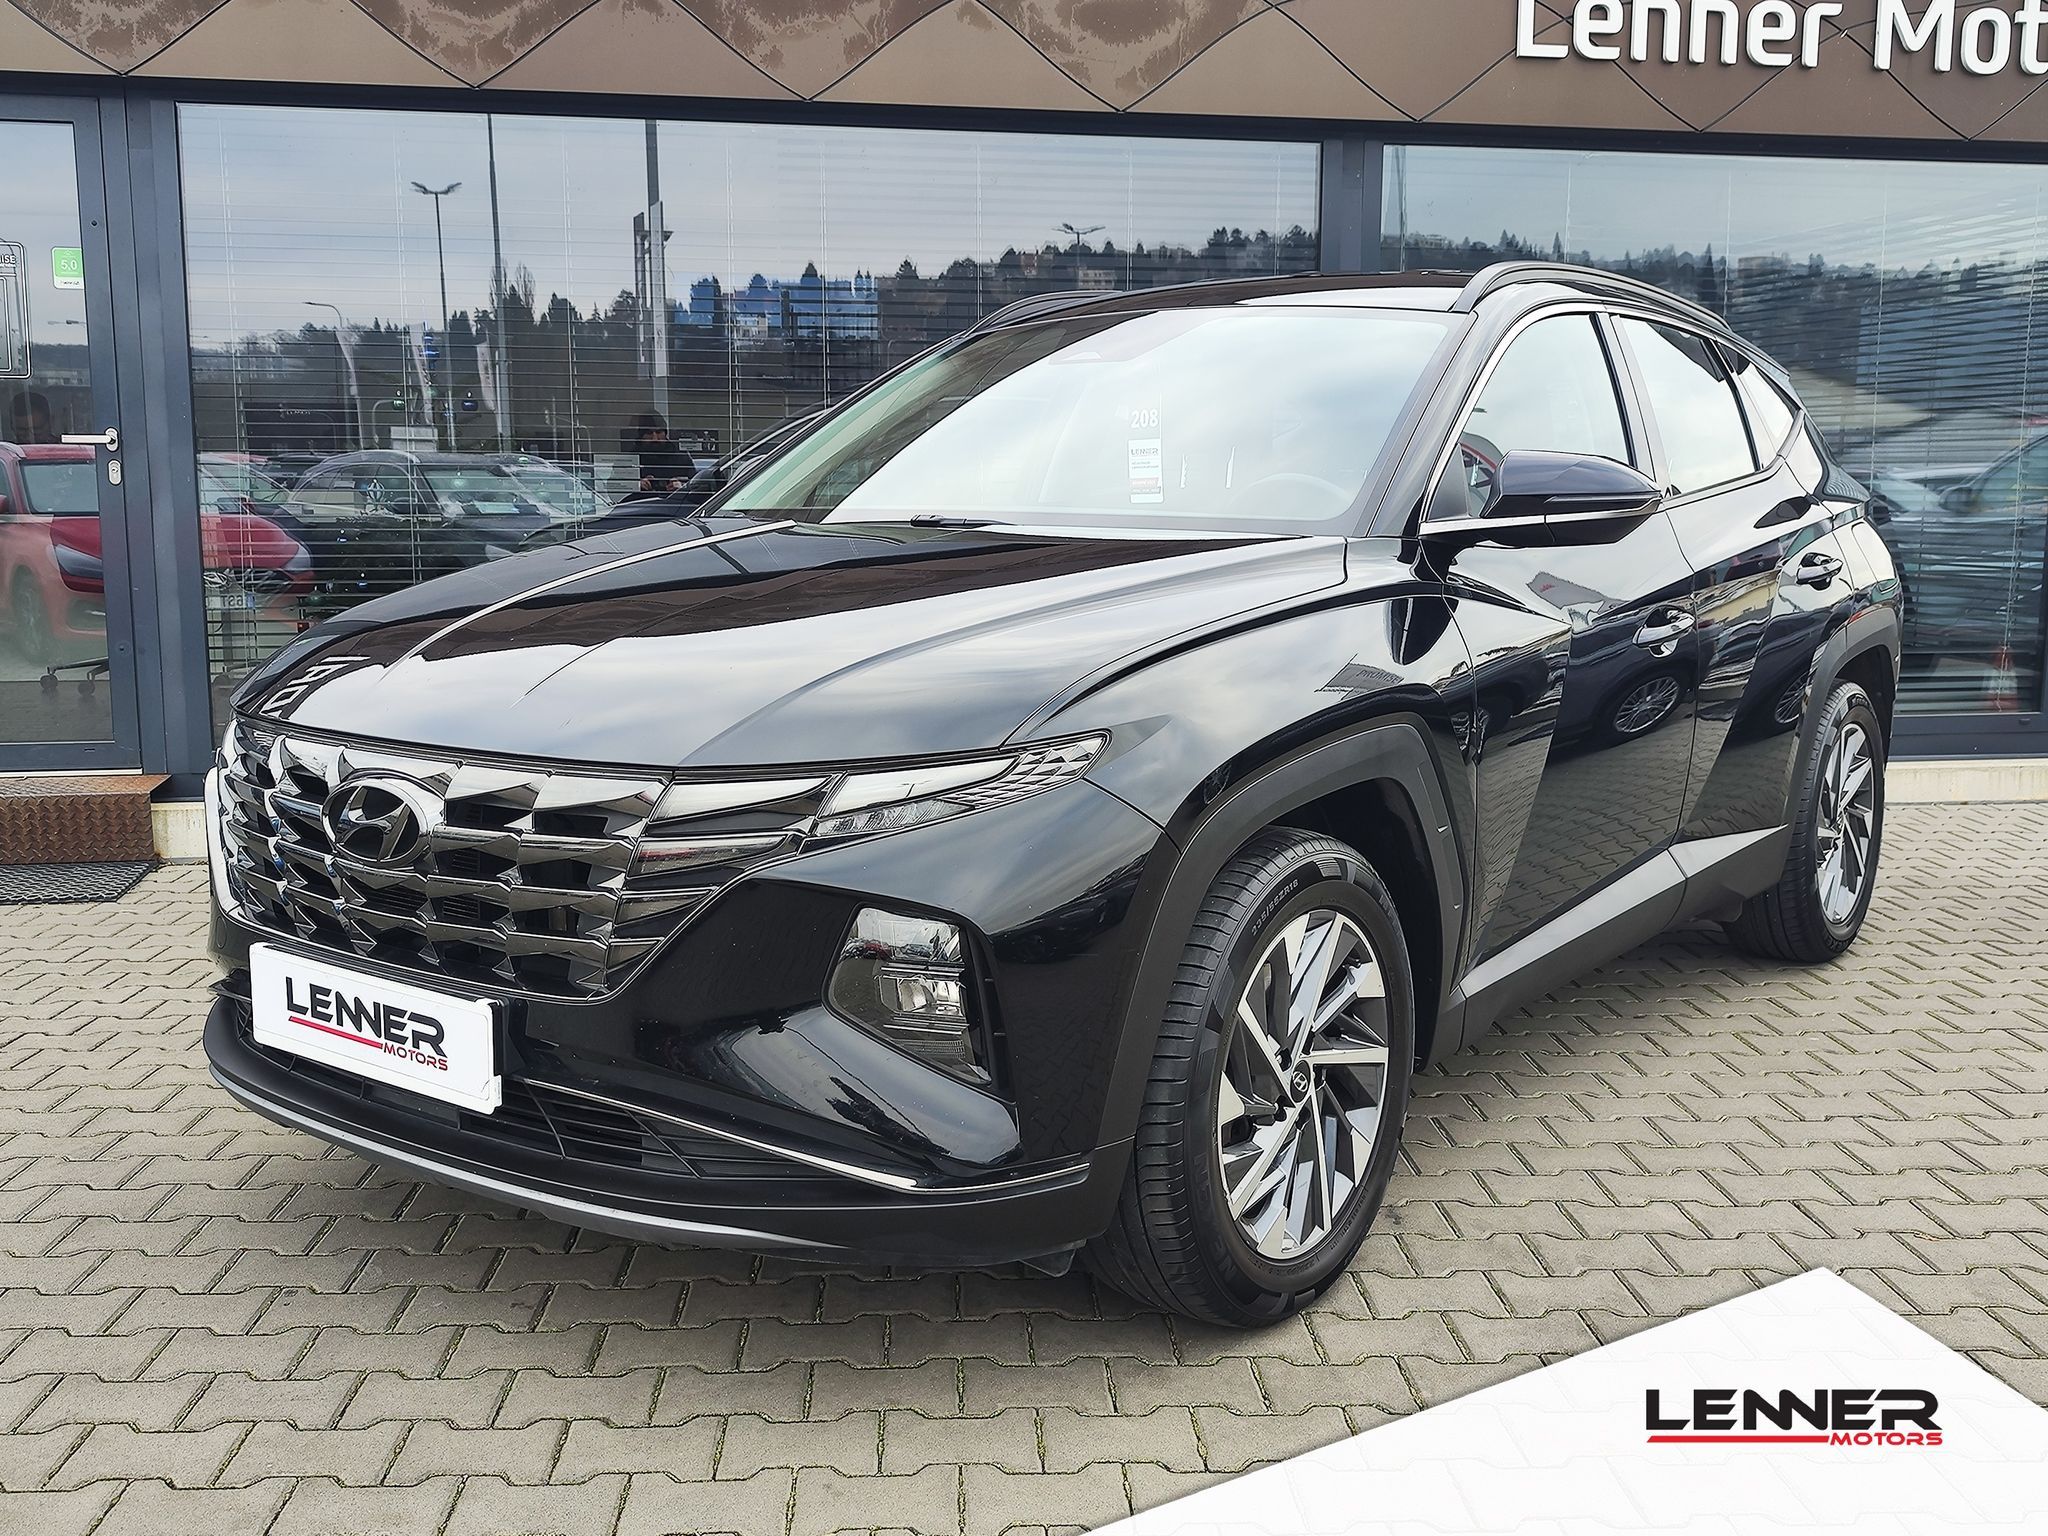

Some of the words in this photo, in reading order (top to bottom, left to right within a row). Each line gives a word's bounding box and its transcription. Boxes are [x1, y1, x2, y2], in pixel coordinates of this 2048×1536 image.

[1516, 0, 1843, 69] Lenner
[1131, 408, 1159, 429] 208
[285, 976, 448, 1058] LENNER
[383, 1041, 448, 1071] MOTORS
